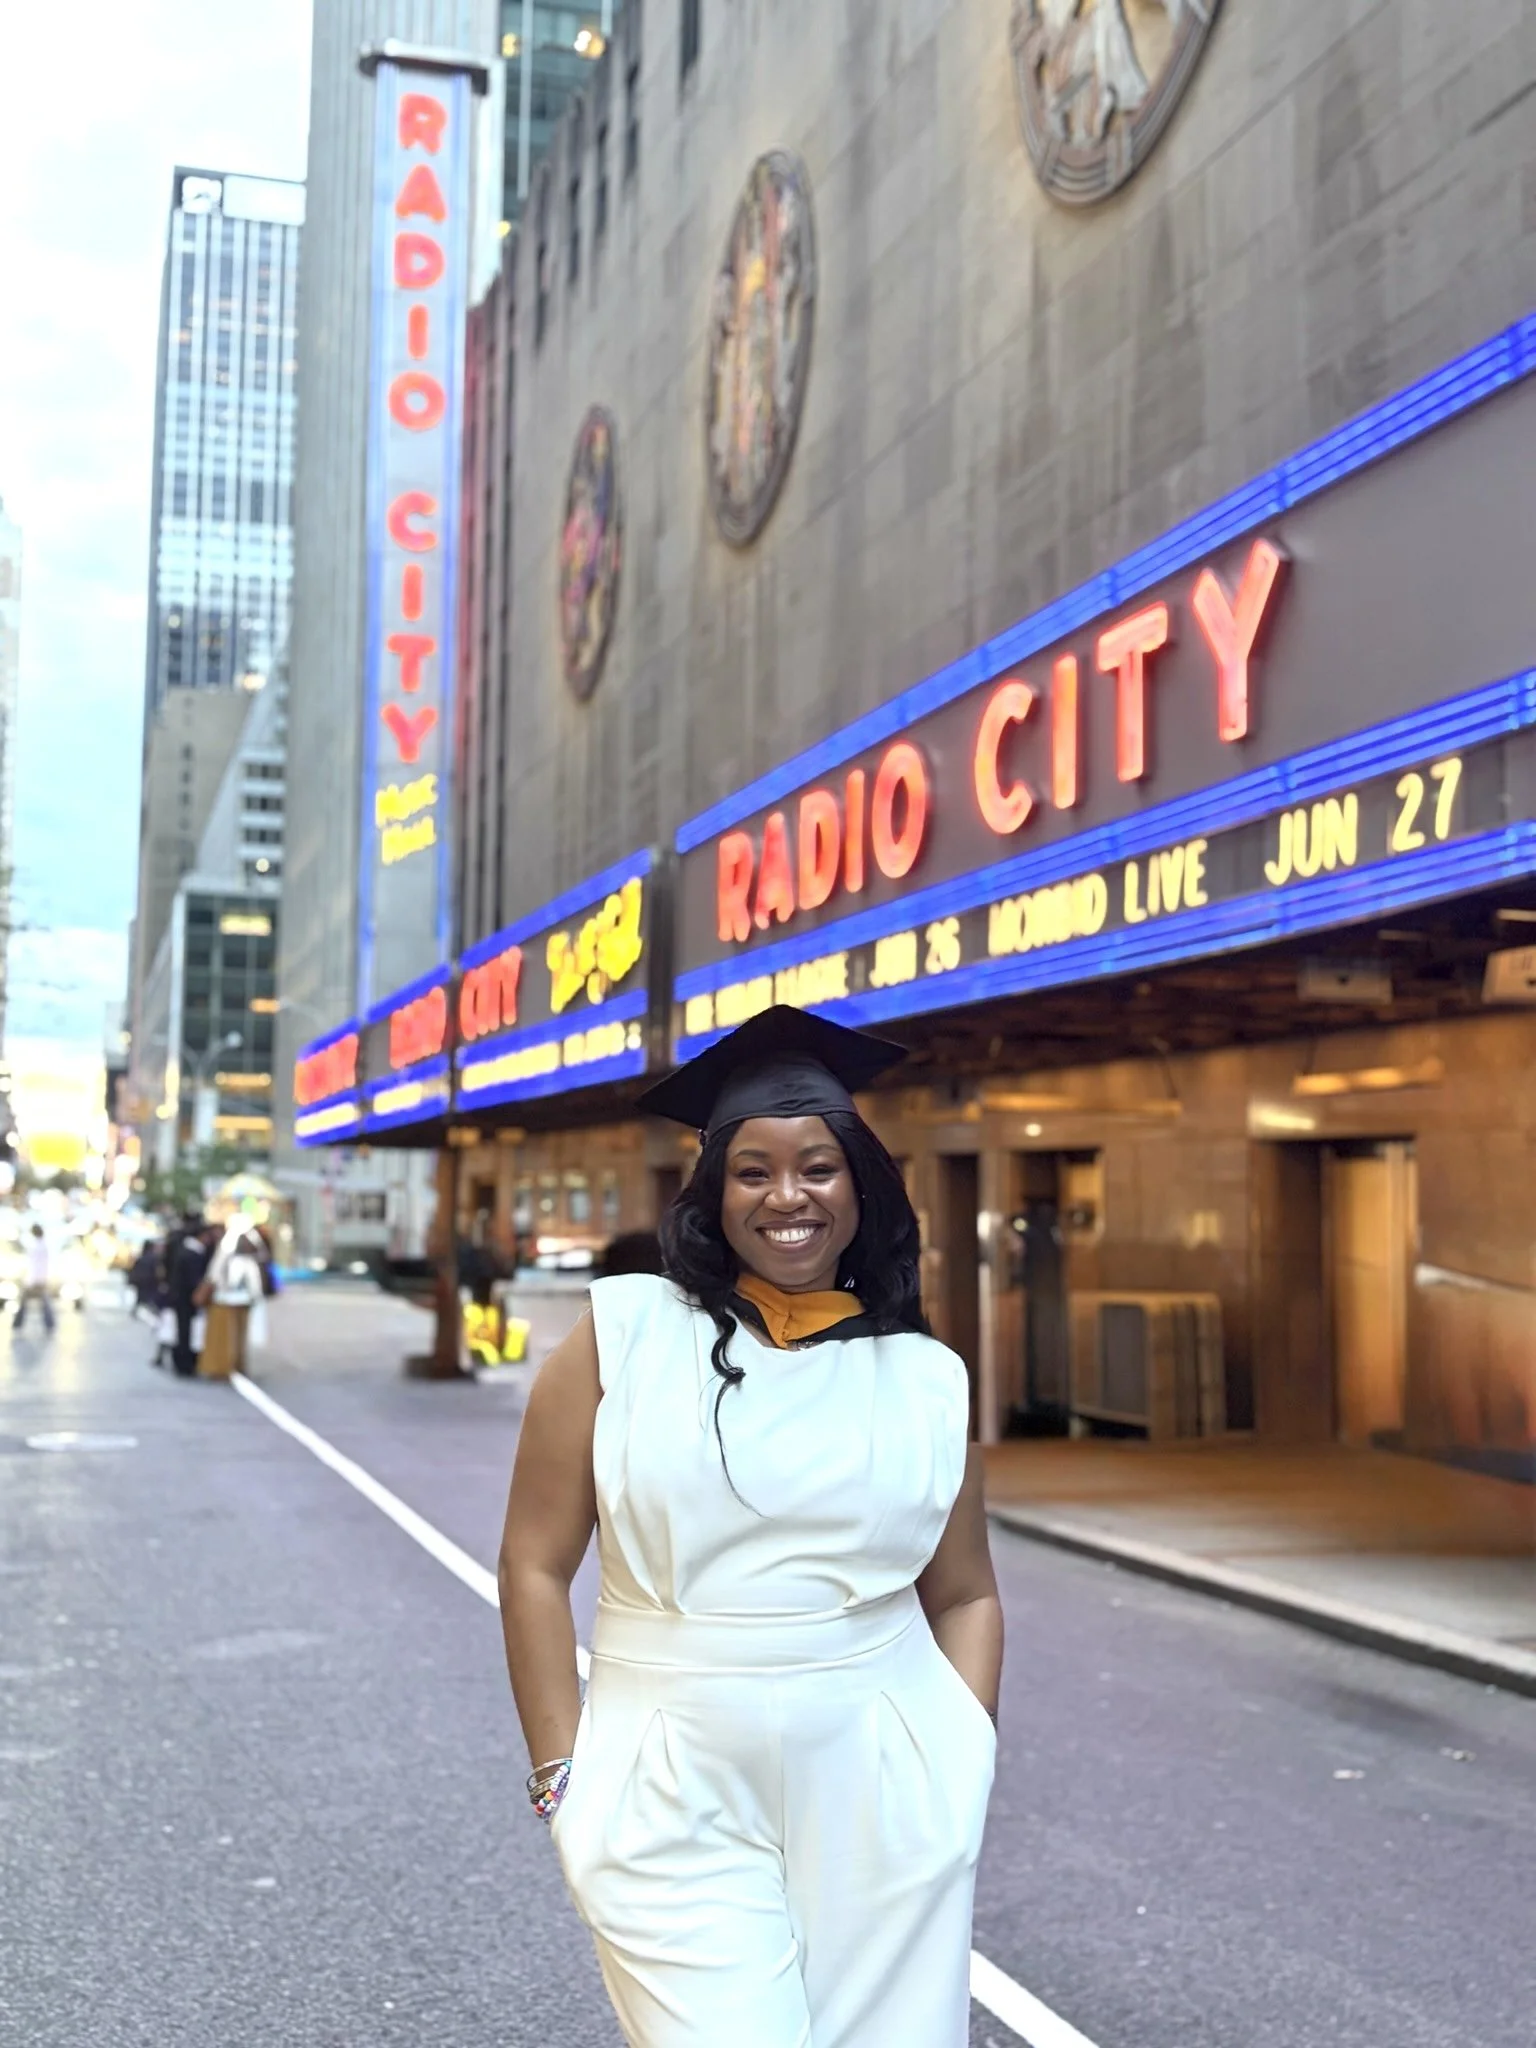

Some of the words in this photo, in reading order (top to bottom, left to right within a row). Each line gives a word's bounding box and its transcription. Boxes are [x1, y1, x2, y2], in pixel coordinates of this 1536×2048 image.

[388, 93, 448, 430] RADIO
[379, 491, 440, 764] CITY
[716, 740, 930, 943] RADIO
[972, 539, 1282, 836] CITY
[1123, 838, 1208, 924] LIVE
[1264, 792, 1359, 886] JUN
[1391, 756, 1463, 853] 27
